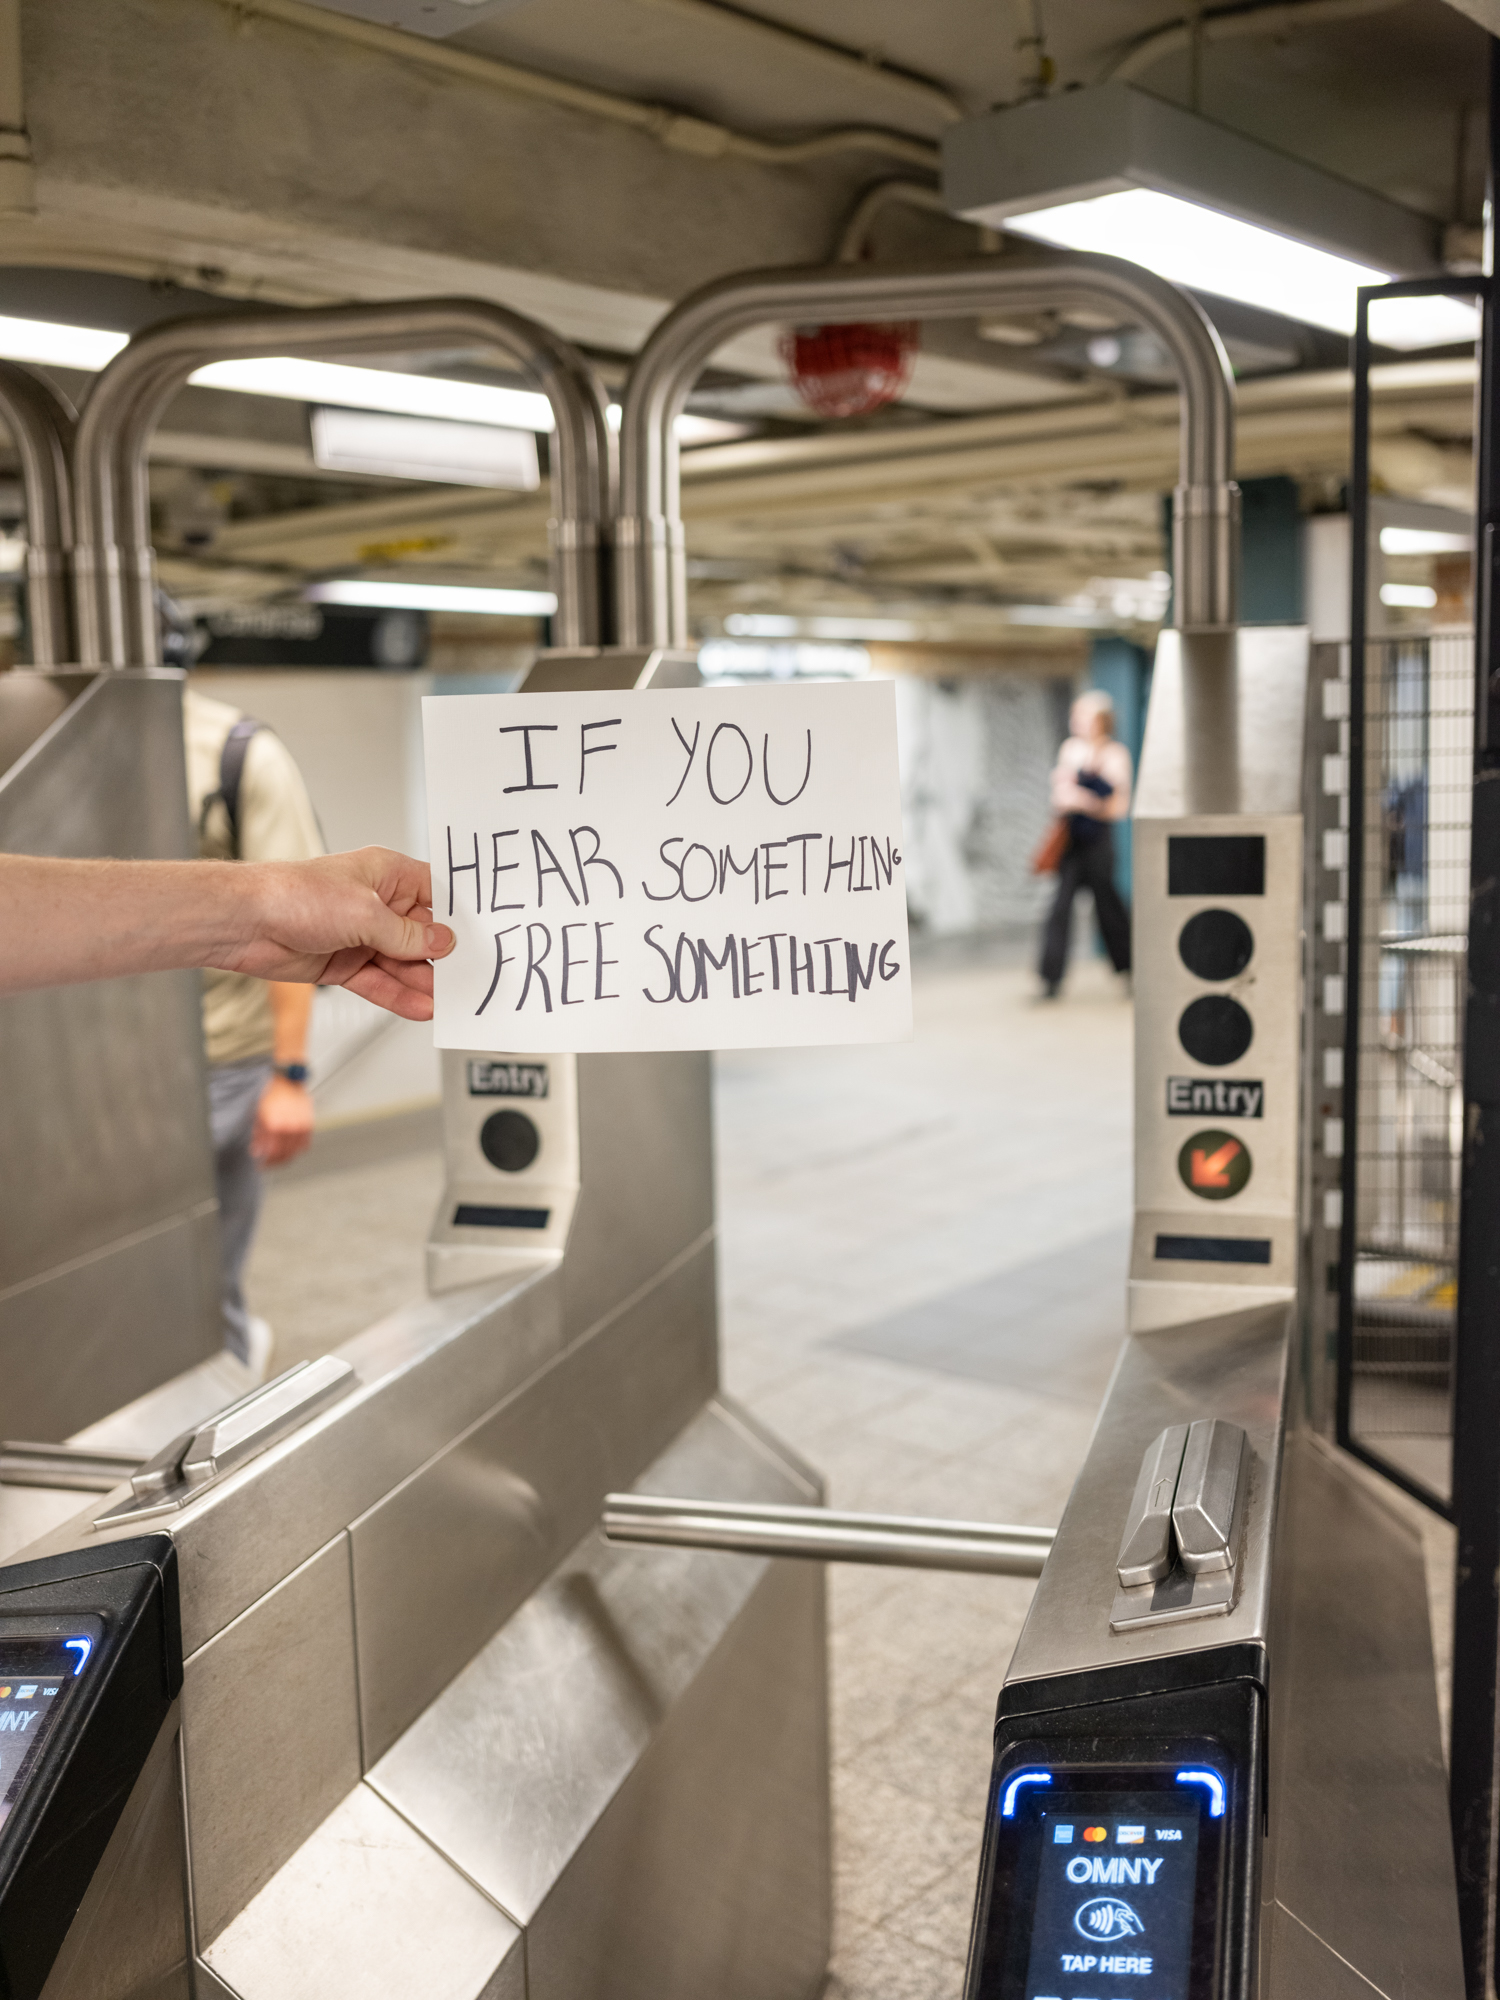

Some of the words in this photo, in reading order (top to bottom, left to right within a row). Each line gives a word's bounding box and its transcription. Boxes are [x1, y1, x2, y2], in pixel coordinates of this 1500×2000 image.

[499, 718, 622, 794] IF
[666, 717, 811, 807] YOU
[446, 825, 624, 917] HEAR
[641, 833, 902, 905] SOMETHING
[475, 921, 620, 1016] FREE
[642, 923, 901, 1004] SOMETHING
[471, 1060, 548, 1098] Entry
[1169, 1080, 1261, 1117] Entry
[1155, 1829, 1183, 1841] VISA
[1066, 1856, 1165, 1885] OMNY
[1060, 1954, 1097, 1973] TAP
[1098, 1955, 1154, 1976] HERE
